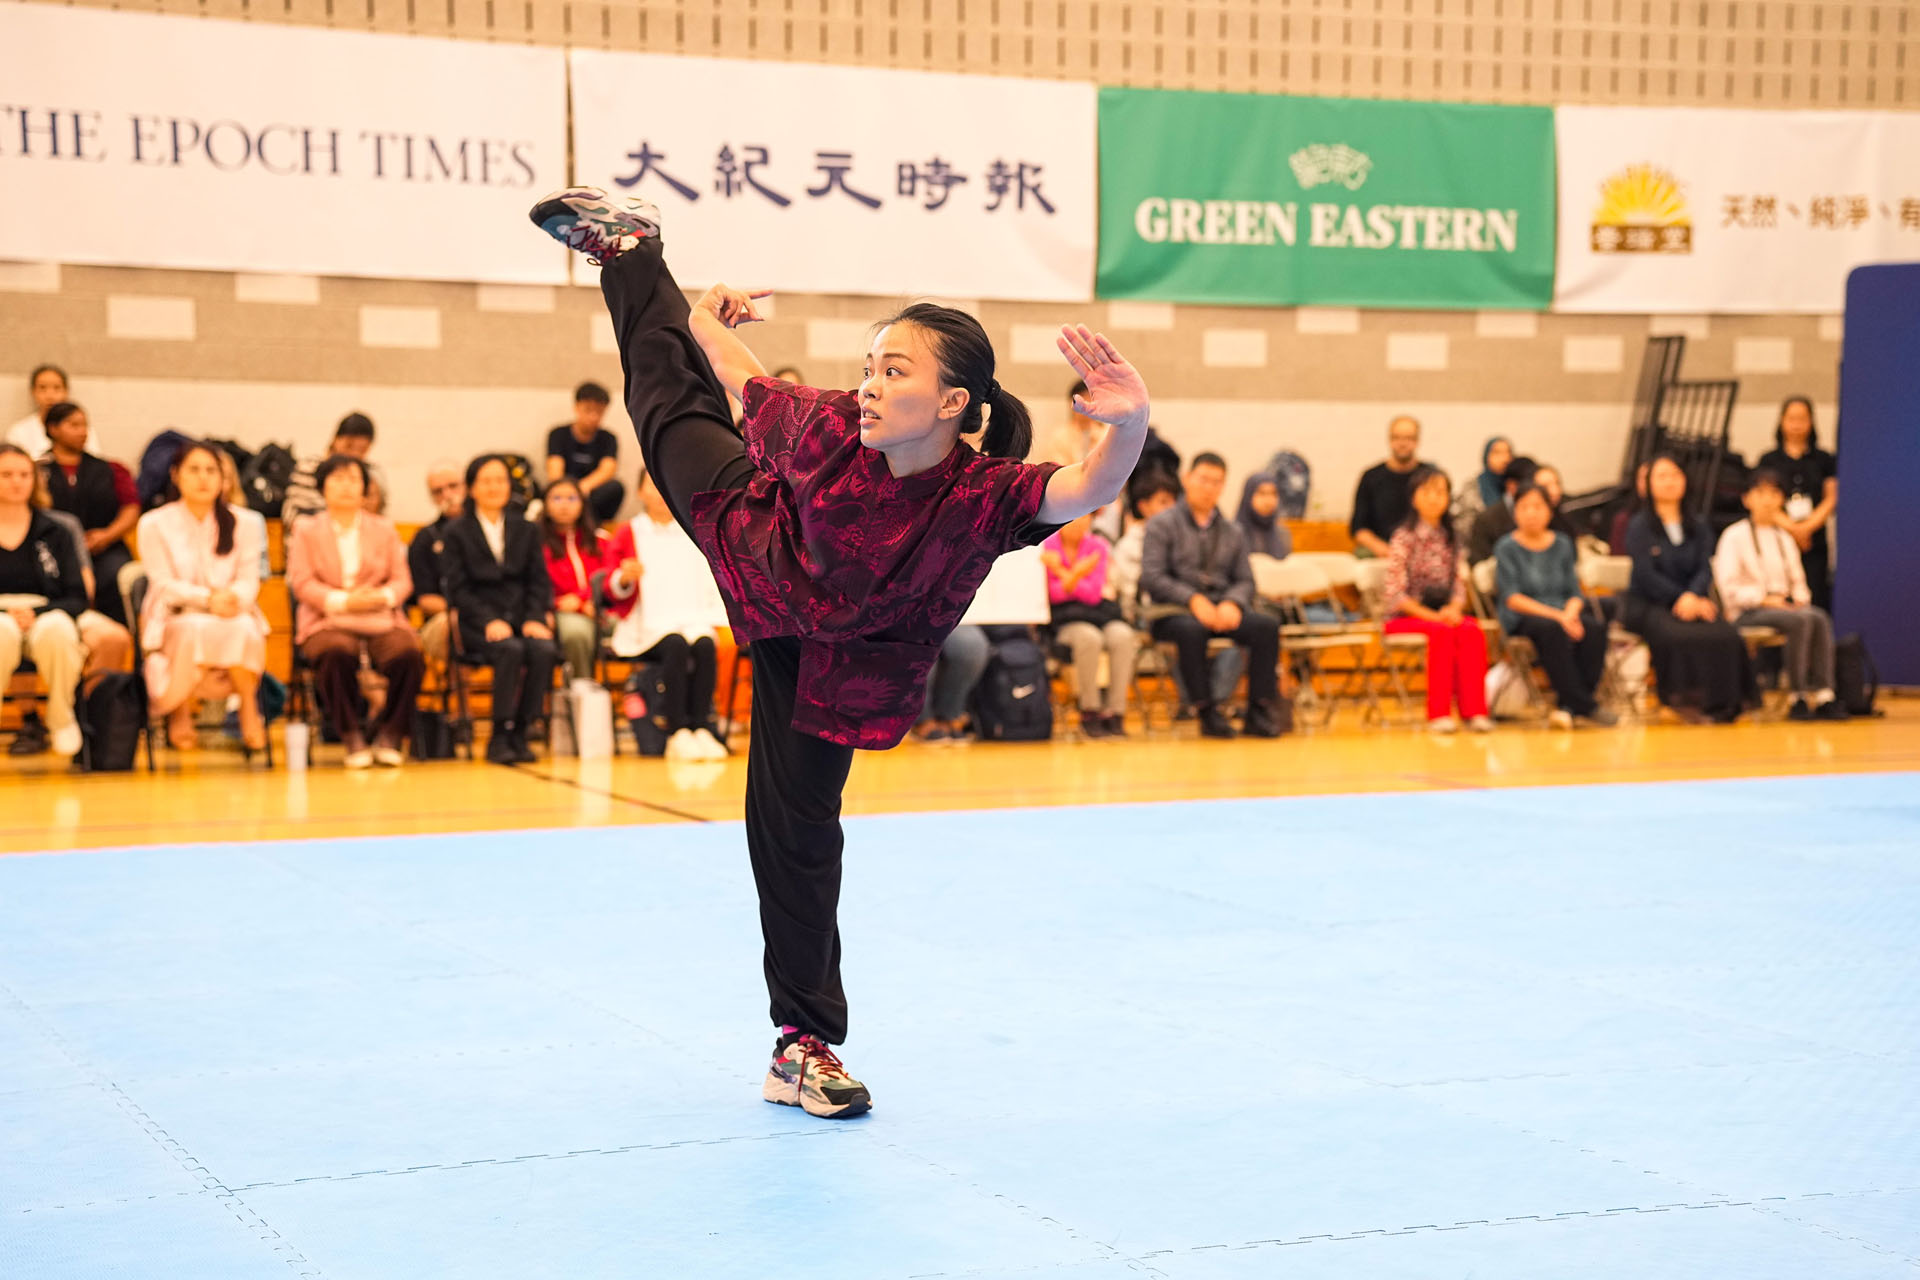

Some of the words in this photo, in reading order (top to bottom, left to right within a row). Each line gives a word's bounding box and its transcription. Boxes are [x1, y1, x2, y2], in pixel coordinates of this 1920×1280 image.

[130, 114, 342, 178] EPOCH
[359, 130, 537, 189] TIMES
[613, 140, 1057, 215] 大紀元時報
[1134, 197, 1298, 247] GREEN
[1309, 203, 1519, 253] EASTERN
